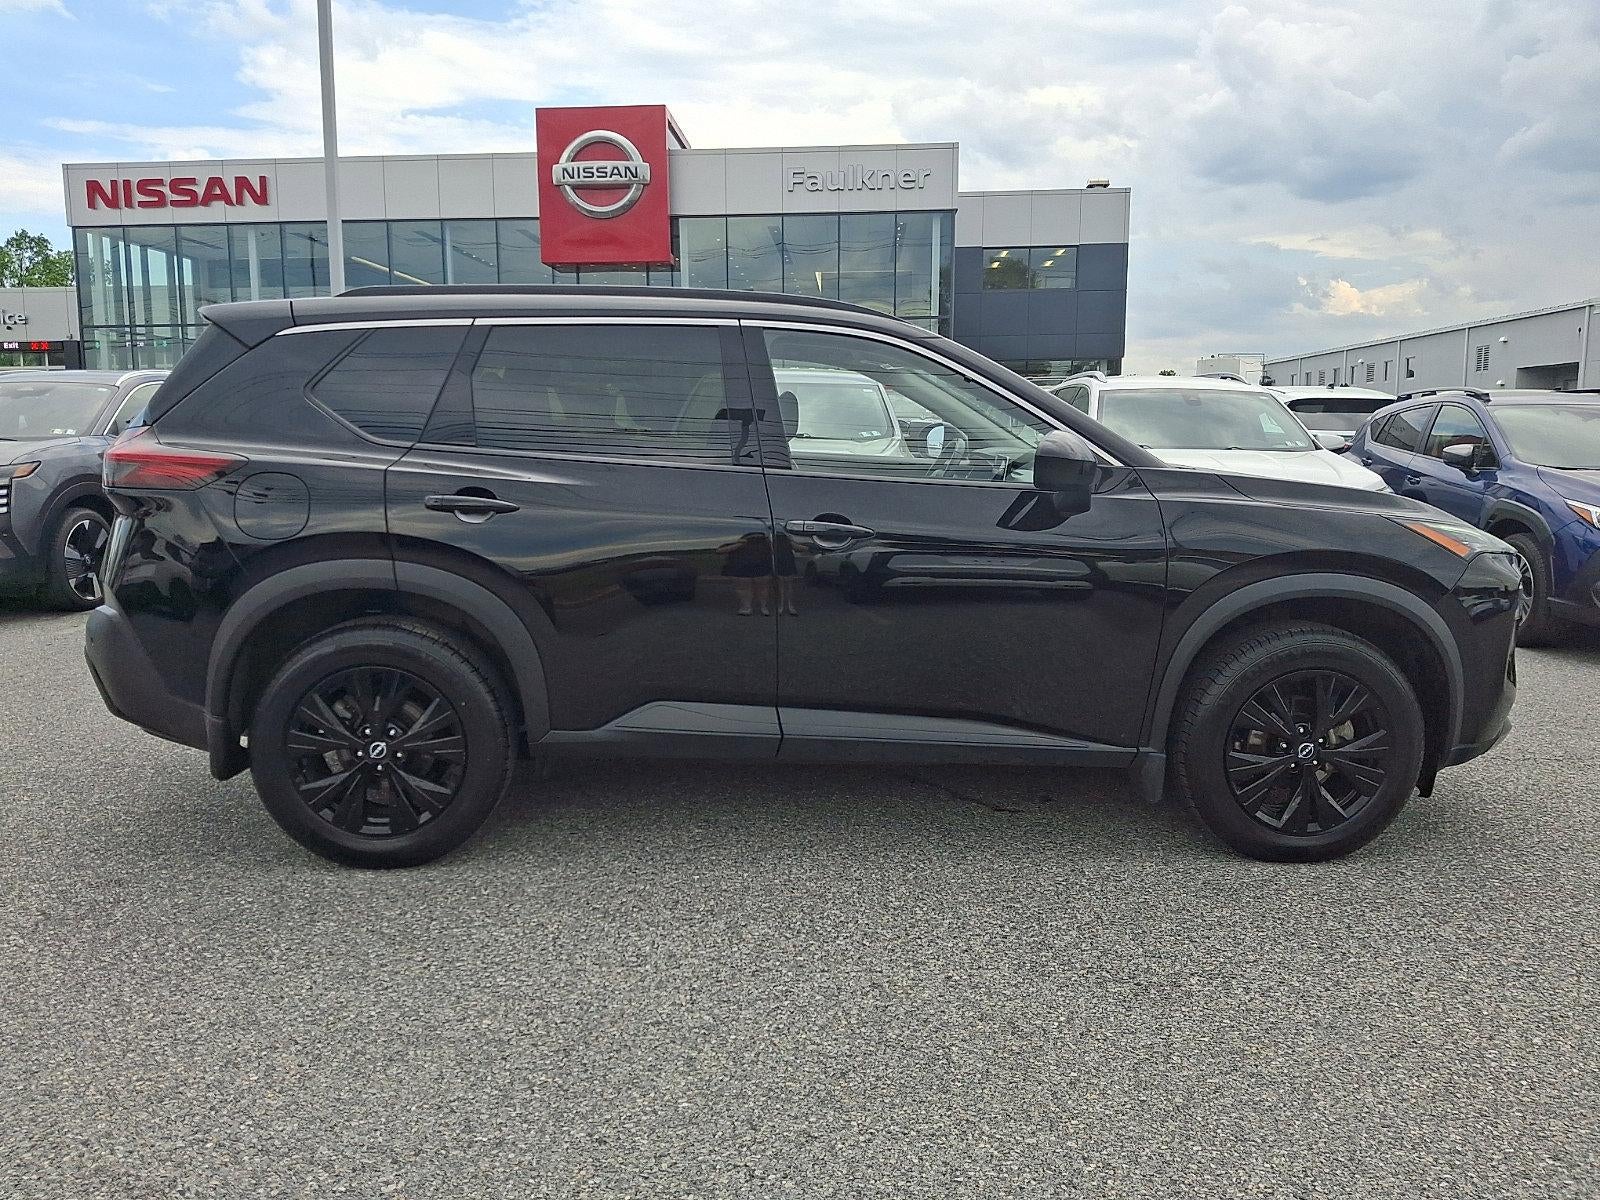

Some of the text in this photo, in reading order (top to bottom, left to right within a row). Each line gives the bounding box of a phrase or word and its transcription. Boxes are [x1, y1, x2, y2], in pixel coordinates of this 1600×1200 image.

[562, 166, 639, 180] NISSAN
[787, 164, 931, 192] Faulkner
[86, 176, 270, 210] NISSAN
